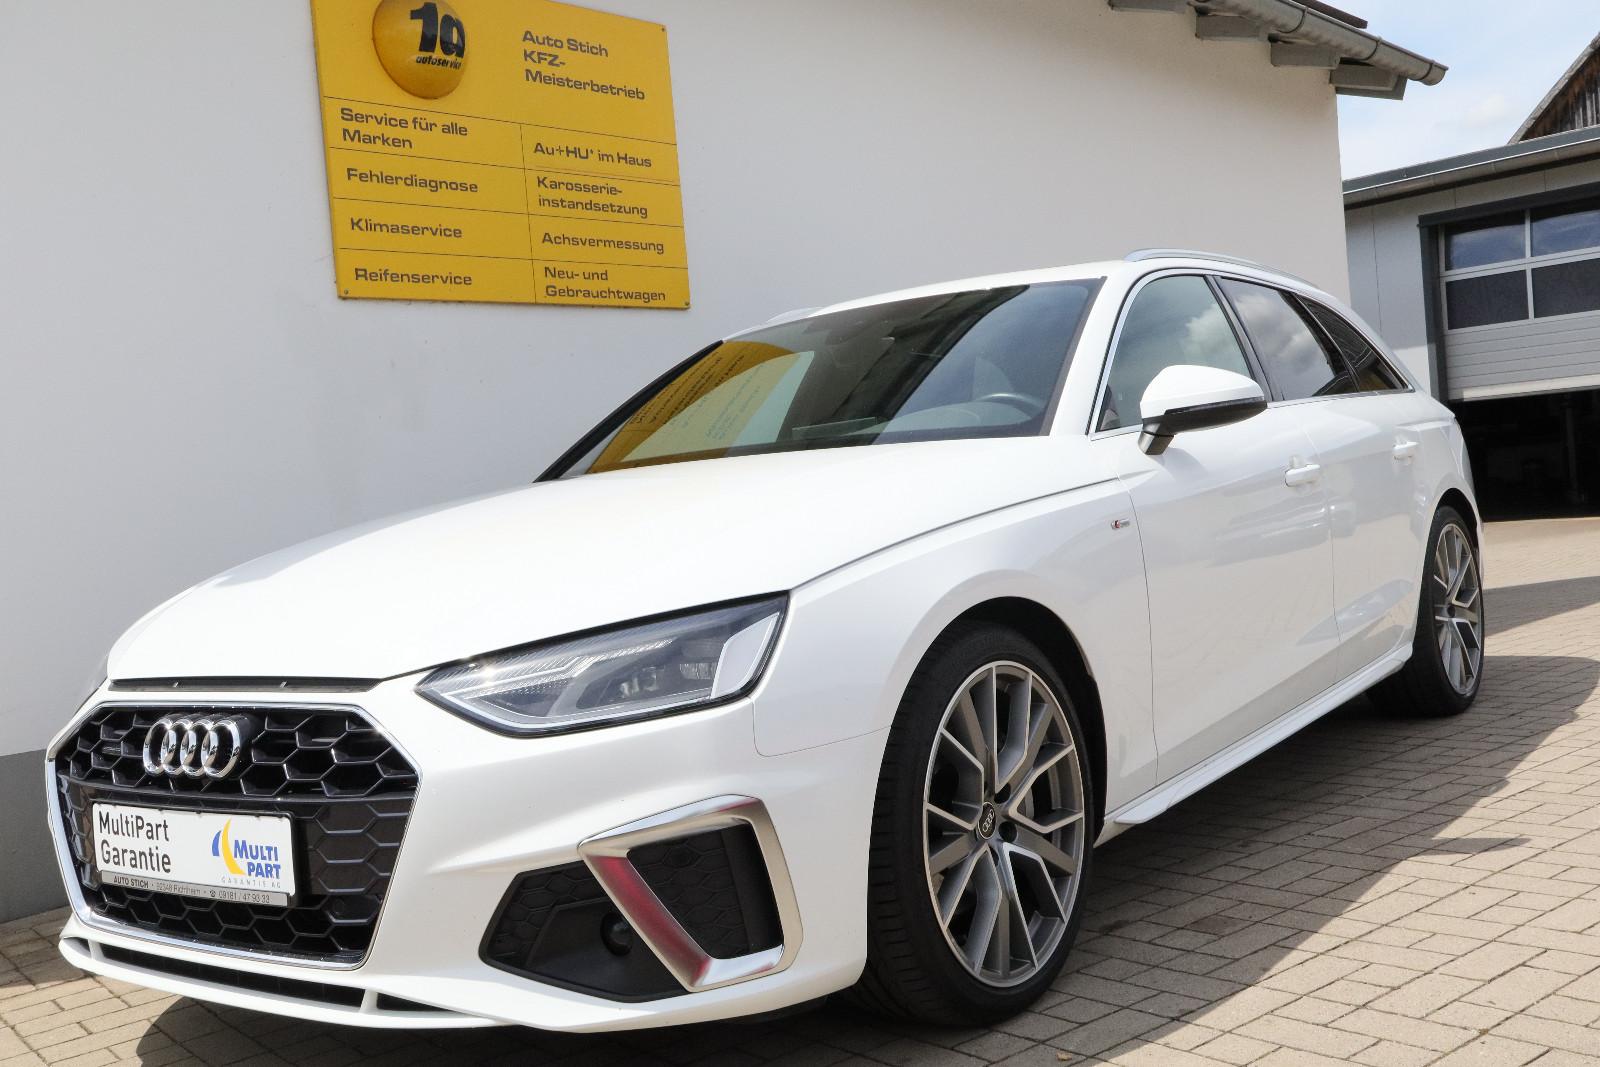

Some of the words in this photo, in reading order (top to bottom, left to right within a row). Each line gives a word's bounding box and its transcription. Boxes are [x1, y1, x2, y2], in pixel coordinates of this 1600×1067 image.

[522, 30, 564, 49] Auto
[567, 37, 609, 57] Stich
[523, 50, 566, 68] KFZ-
[525, 69, 645, 101] Meisterbetrieb
[340, 107, 408, 130] Service
[411, 114, 437, 134] für
[441, 122, 468, 137] alle
[342, 128, 413, 149] Marken
[598, 150, 614, 163] im
[617, 152, 652, 168] Haus
[346, 167, 478, 194] Fehlerdiagnose
[536, 176, 623, 196] Karosserie-
[538, 195, 648, 219] instandsetzung
[350, 217, 462, 239] Klimaservice
[542, 232, 664, 254] Achsvermessung
[354, 267, 473, 287] Reifenservice
[544, 266, 580, 281] Neu-
[582, 267, 609, 282] und
[545, 285, 666, 303] Gebrauchtwagen
[99, 811, 169, 841] MultiPart
[101, 840, 171, 873] Garantie
[234, 840, 278, 861] MULTI
[247, 862, 280, 879] PART
[113, 876, 130, 885] AUTO
[131, 879, 149, 888] STICH
